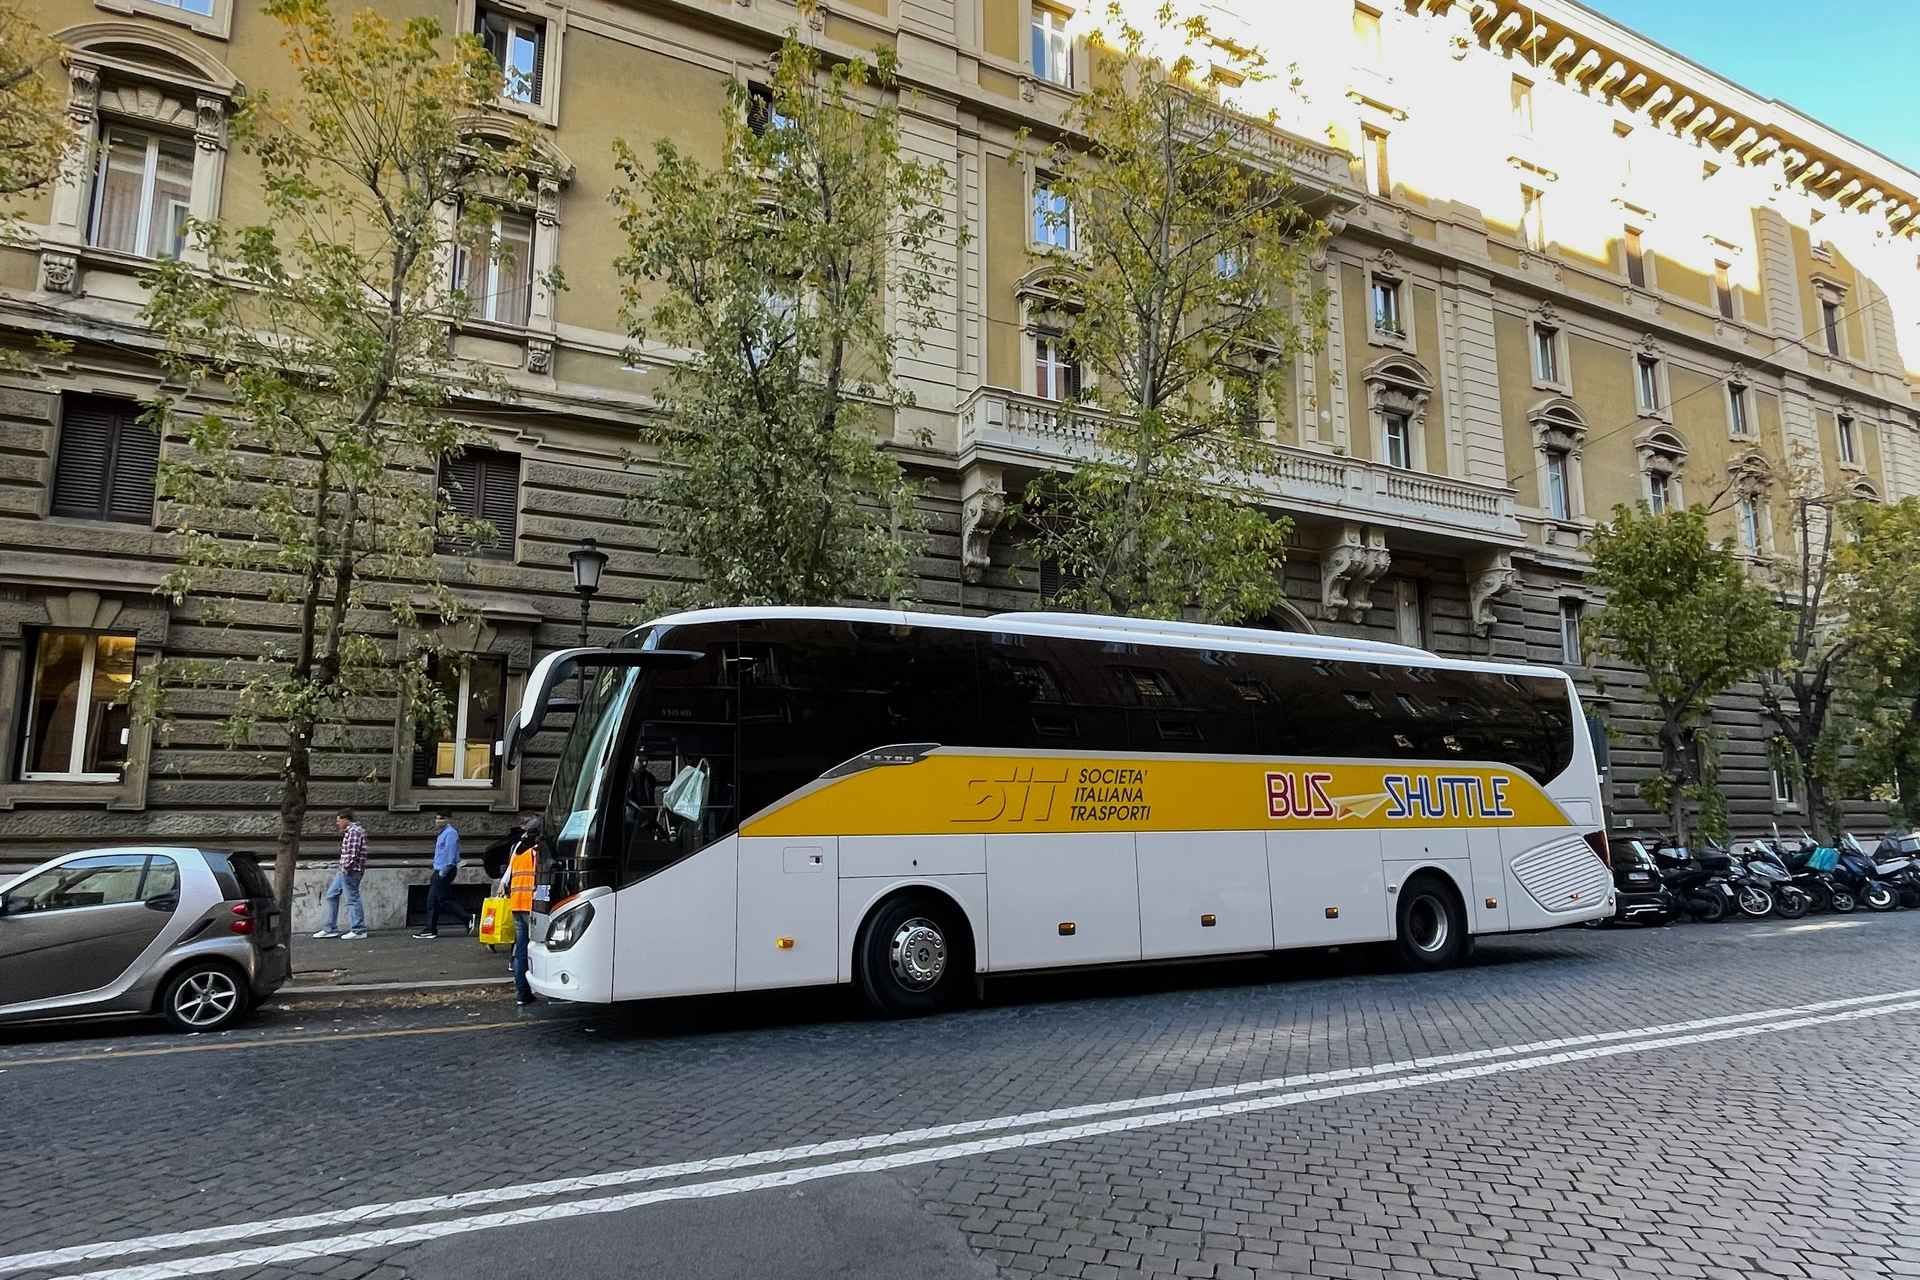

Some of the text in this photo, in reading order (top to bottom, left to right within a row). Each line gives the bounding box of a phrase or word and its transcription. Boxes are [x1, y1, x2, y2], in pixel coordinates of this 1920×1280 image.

[1078, 768, 1148, 785] SOCIETA'
[1074, 787, 1144, 803] ITALIANA
[1265, 772, 1515, 820] BUS SHUTTLE
[1069, 805, 1151, 822] TRASPORTI
